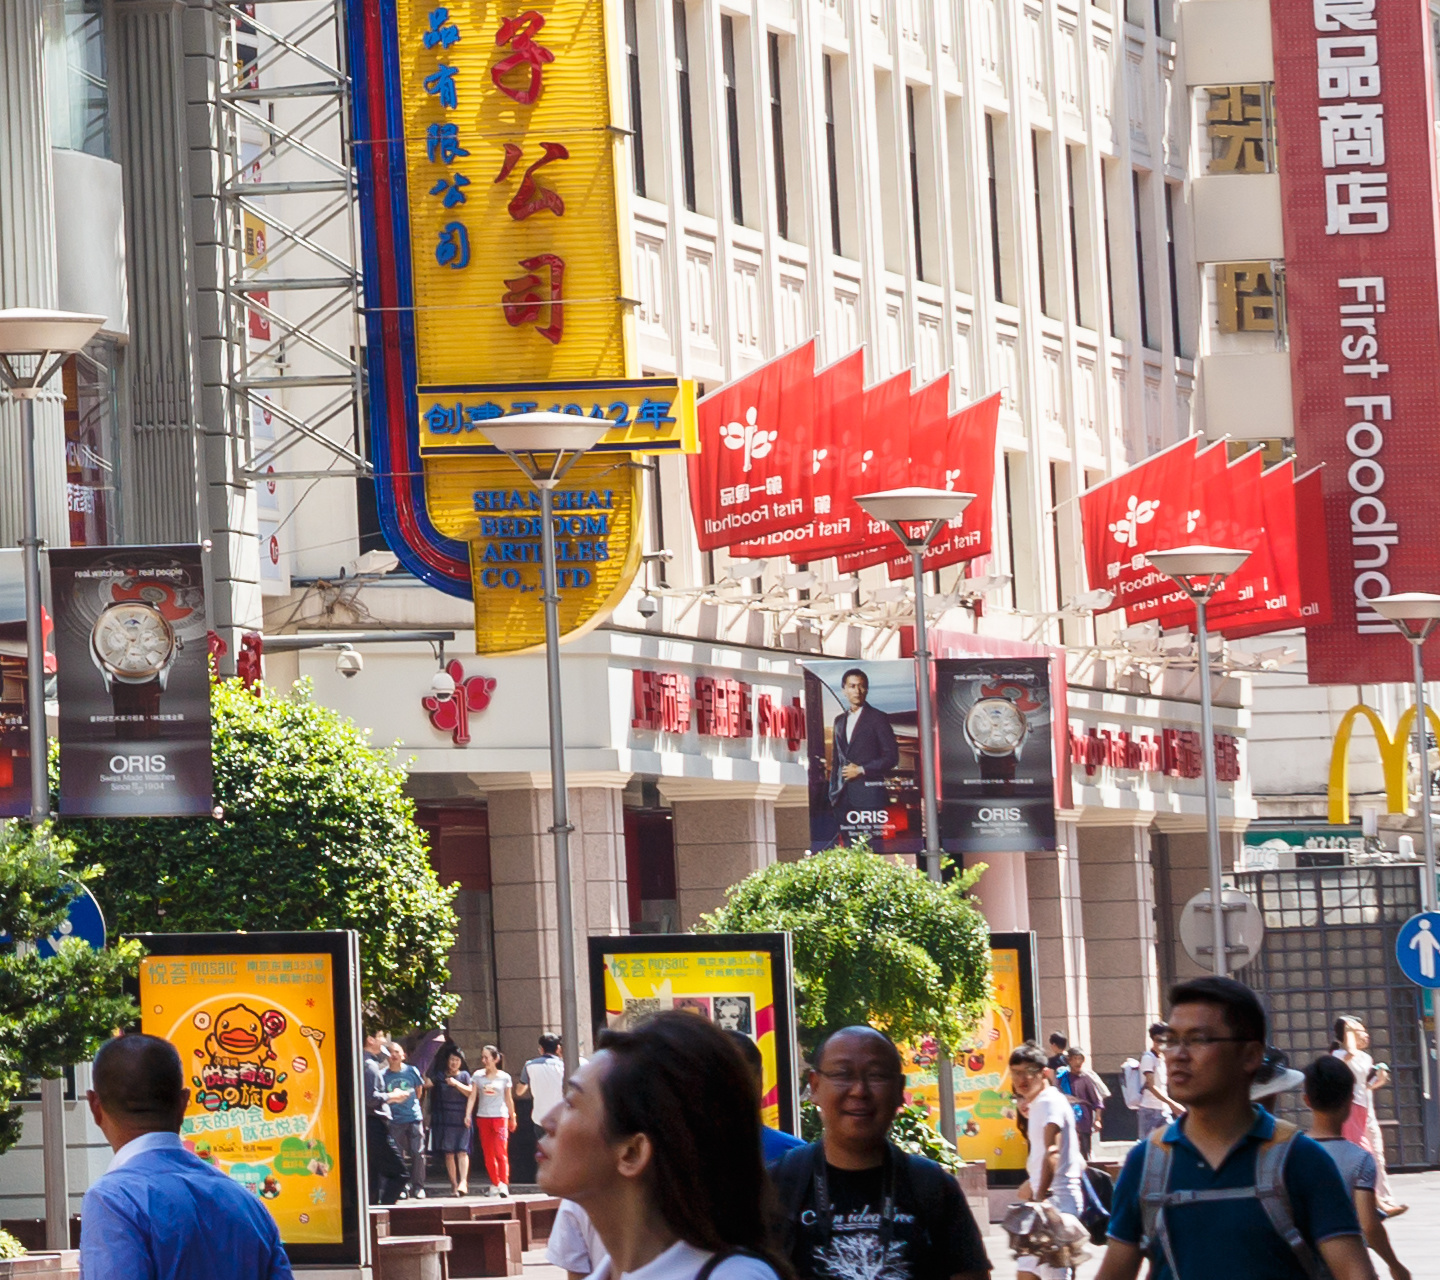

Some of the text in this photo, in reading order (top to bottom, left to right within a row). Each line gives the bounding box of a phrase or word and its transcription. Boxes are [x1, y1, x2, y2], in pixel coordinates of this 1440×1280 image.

[1338, 275, 1398, 635] First Foodhall
[110, 755, 166, 774] ORIS
[847, 810, 889, 823] ORIS
[978, 807, 1020, 821] ORIS
